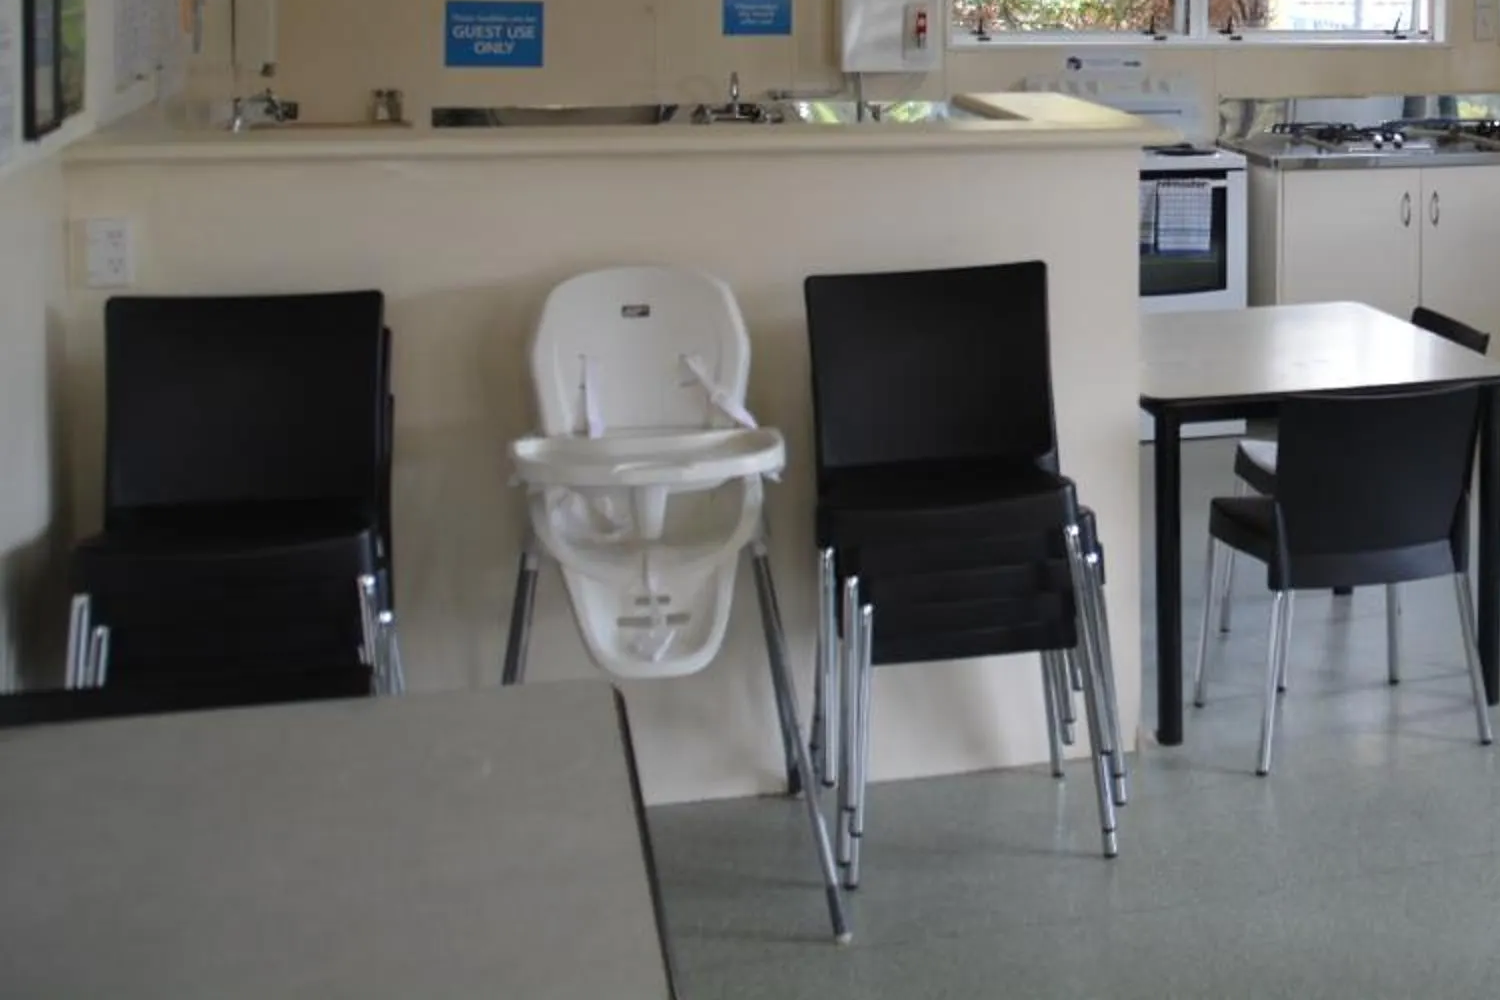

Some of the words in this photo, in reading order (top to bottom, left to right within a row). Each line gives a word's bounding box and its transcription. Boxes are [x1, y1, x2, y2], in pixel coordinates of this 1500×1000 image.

[452, 24, 503, 39] GUEST
[506, 24, 536, 39] USE
[474, 40, 516, 55] ONLY
